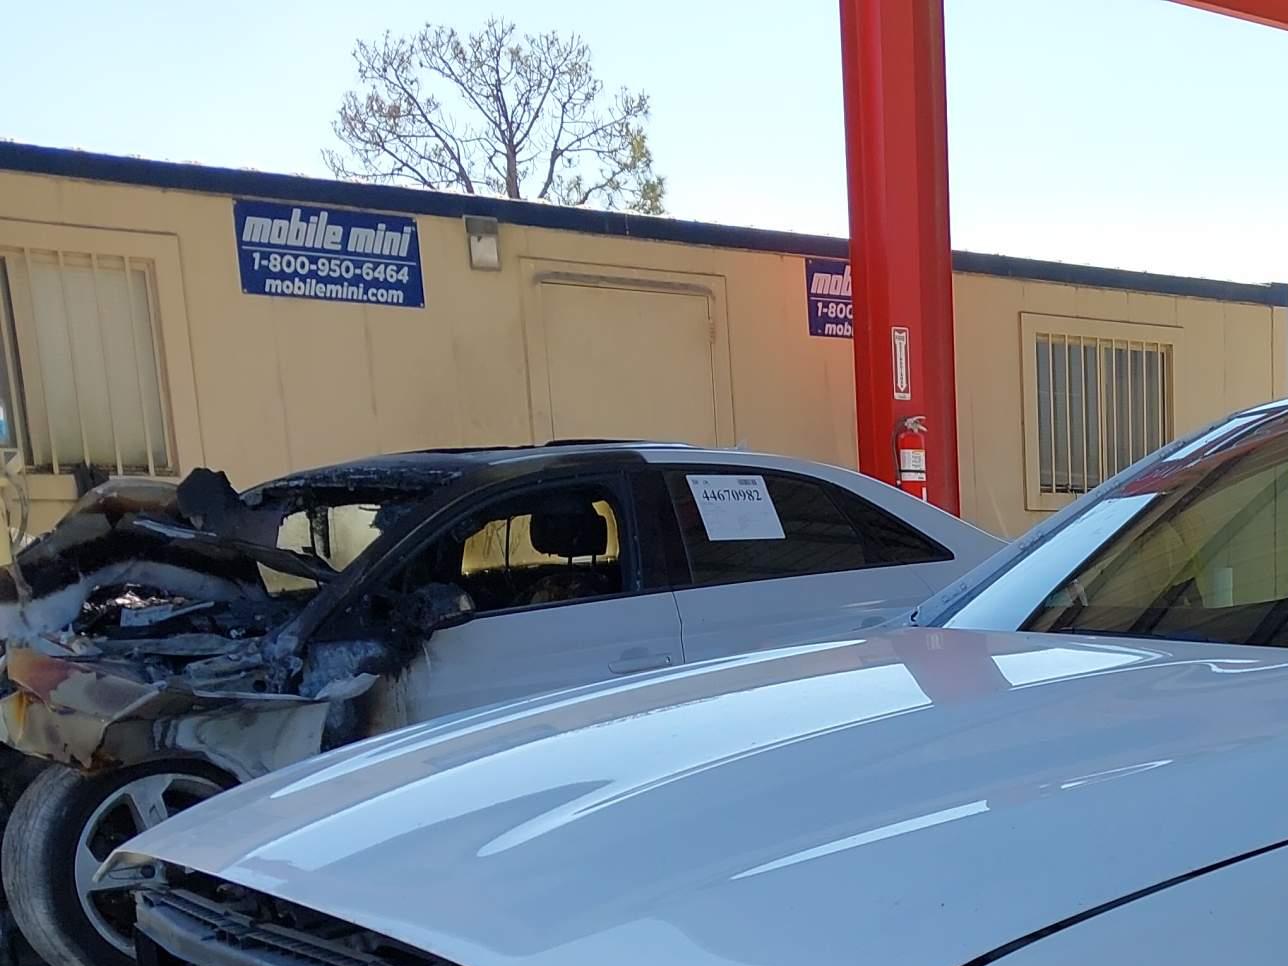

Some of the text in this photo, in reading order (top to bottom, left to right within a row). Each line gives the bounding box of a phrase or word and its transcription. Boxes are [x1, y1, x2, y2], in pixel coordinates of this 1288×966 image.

[242, 208, 411, 257] mobile mini
[252, 252, 409, 284] 1-800-950-6464
[265, 277, 403, 303] mobilemini.com
[824, 321, 853, 337] mob
[702, 488, 763, 502] 44670982
